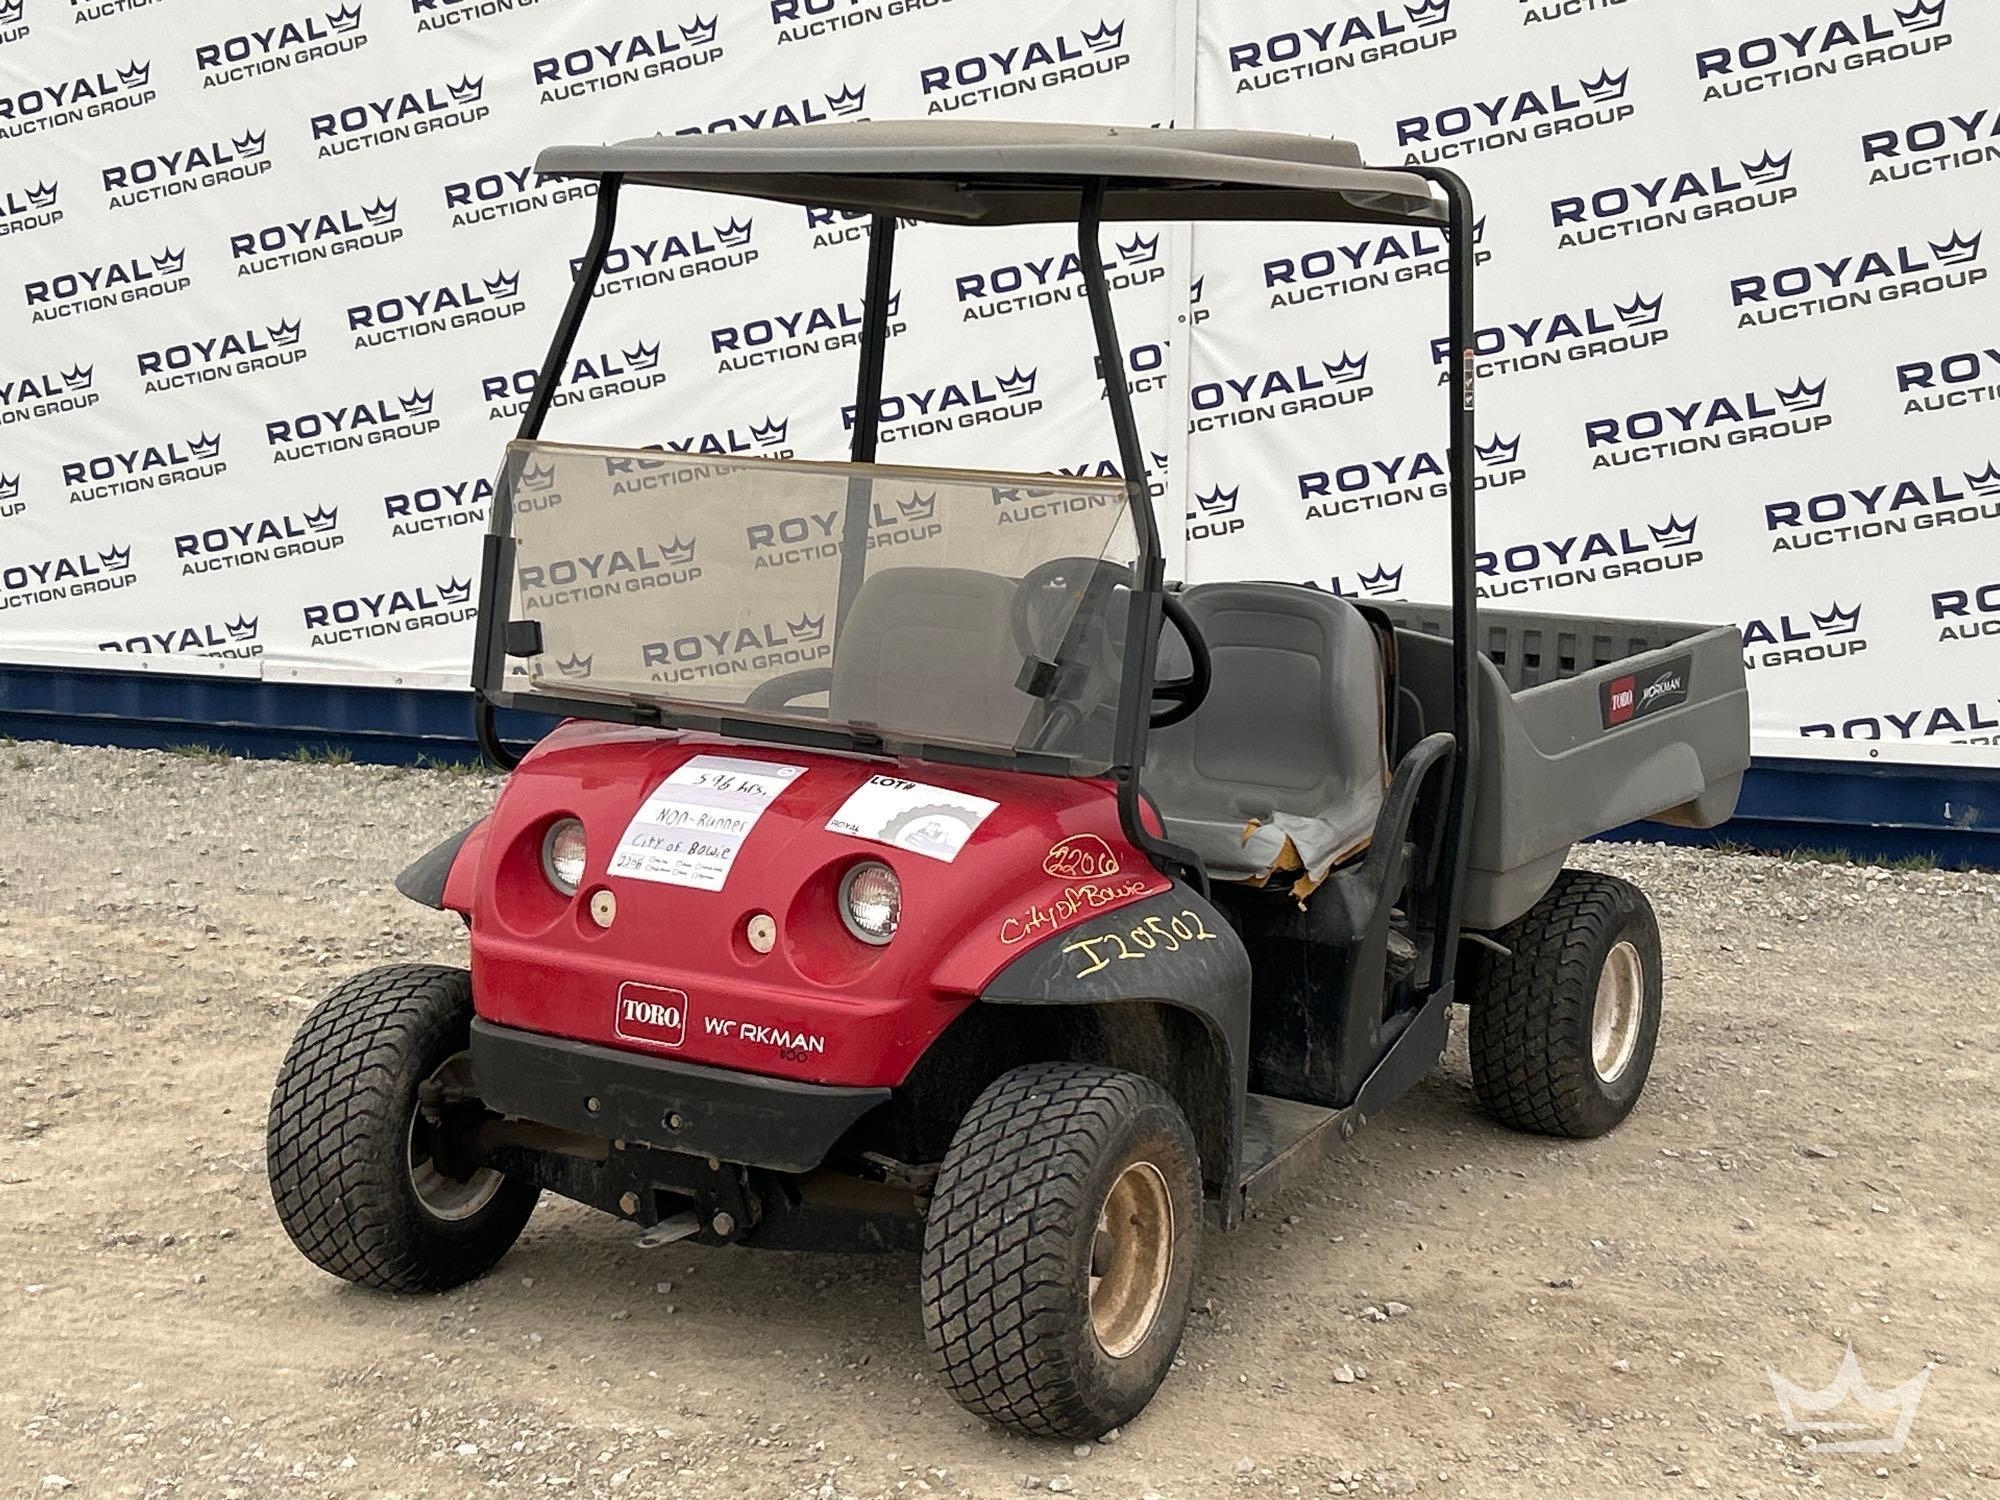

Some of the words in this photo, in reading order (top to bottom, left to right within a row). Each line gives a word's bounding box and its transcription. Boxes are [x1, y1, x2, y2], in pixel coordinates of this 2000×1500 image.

[75, 0, 161, 24] AUCTIO
[418, 0, 512, 34] AUCTION
[778, 6, 882, 45] AUCTION
[196, 18, 328, 71] ROYAL
[203, 54, 291, 89] AUCTION
[295, 35, 367, 64] GROUP
[533, 30, 681, 86] ROYAL
[920, 36, 1083, 95] ROYAL
[1229, 10, 1406, 73] ROYAL
[1237, 53, 1354, 94] AUCTION
[1361, 29, 1457, 64] GROUP
[1696, 14, 1895, 80] ROYAL
[541, 68, 639, 105] AUCTION
[644, 47, 724, 78] GROUP
[928, 77, 1036, 115] AUCTION
[1042, 54, 1130, 87] GROUP
[1704, 59, 1836, 102] AUCTION
[1844, 34, 1952, 70] GROUP
[0, 109, 82, 141] AUCTION
[87, 90, 156, 118] GROUP
[311, 88, 449, 140] ROYAL
[318, 125, 410, 159] AUCTION
[414, 106, 489, 135] GROUP
[1396, 85, 1580, 147] ROYAL
[1404, 128, 1526, 168] AUCTION
[1534, 105, 1634, 139] GROUP
[1861, 104, 2000, 163] ROY
[102, 142, 234, 192] ROYAL
[110, 178, 197, 210] AUCTION
[201, 160, 272, 187] GROUP
[445, 166, 564, 209] ROYA
[453, 194, 547, 228] AUCTION
[552, 183, 599, 204] GRO
[1551, 167, 1742, 228] ROYAL
[1559, 210, 1686, 249] AUCTION
[1693, 187, 1797, 221] GROUP
[0, 210, 64, 236] GROUP
[231, 210, 364, 259] ROYAL
[238, 246, 326, 277] AUCTION
[331, 228, 403, 255] GROUP
[590, 268, 674, 298] UCTION
[679, 250, 759, 278] GROUP
[1263, 231, 1440, 288] ROYAL
[25, 259, 153, 306] ROYAL
[32, 293, 117, 324] AUCTION
[121, 277, 191, 303] GROUP
[955, 252, 1118, 302] ROYA
[1271, 272, 1388, 309] AUCTION
[1395, 251, 1491, 283] GROP
[1730, 247, 1930, 307] ROYAL
[1738, 290, 1871, 329] AUCTION
[1879, 268, 1987, 301] GROUP
[347, 283, 485, 331] ROYAL
[355, 318, 446, 350] AUCTION
[451, 302, 526, 328] GROUP
[711, 303, 863, 354] ROYAL
[963, 287, 1071, 322] AUCTION
[137, 330, 268, 376] ROYAL
[145, 365, 232, 394] AUCTION
[236, 349, 307, 374] GROUP
[719, 341, 819, 374] AUCTION
[1438, 350, 1561, 386] ACTION
[1568, 330, 1668, 361] GROUP
[0, 375, 63, 405] YAL
[481, 354, 625, 402] ROAL
[589, 373, 667, 400] GROUP
[1190, 365, 1325, 411] OYAL
[1904, 382, 2000, 415] AUCTI
[33, 393, 100, 417] GROUP
[266, 400, 401, 446] ROYAL
[880, 417, 953, 443] CTION
[958, 400, 1043, 428] GROUP
[1187, 405, 1275, 435] UCTION
[1282, 386, 1375, 416] GROUP
[1585, 393, 1776, 449] ROYAL
[62, 443, 189, 487] ROYAL
[274, 435, 363, 464] AUCTION
[367, 419, 440, 444] GROUP
[1593, 434, 1720, 470] AUCTION
[1728, 415, 1832, 446] GROUP
[70, 476, 154, 504] AUCTION
[158, 462, 227, 486] GROUP
[384, 478, 499, 519] ROYA
[613, 465, 710, 496] AUCTION
[1298, 451, 1449, 500] ROYA
[1306, 487, 1423, 520] AUCTION
[1430, 469, 1526, 498] GOUP
[392, 509, 484, 537] AUCTION
[514, 494, 563, 513] OUP
[746, 503, 898, 551] ROYL
[998, 493, 1106, 525] AUCTION
[1765, 476, 1964, 531] ROYAL
[174, 516, 306, 558] ROYAL
[1188, 519, 1246, 539] OUP
[1773, 518, 1906, 553] AUCTION
[1914, 503, 2000, 530] GROU
[3, 555, 101, 590] OYAL
[183, 549, 269, 576] AUCTION
[273, 535, 344, 559] GROUP
[518, 547, 661, 592] ROYAL
[754, 543, 841, 570] AUCTIO
[1475, 528, 1649, 580] ROYAL
[1475, 568, 1595, 601] AUCTION
[1603, 551, 1703, 579] GROUP
[0, 587, 67, 610] UCTION
[70, 574, 138, 596] GROUP
[303, 587, 438, 630] ROYAL
[526, 582, 621, 610] AUCTION
[625, 568, 703, 592] GROUP
[312, 621, 401, 648] AUCTION
[405, 608, 478, 631] GROUP
[641, 624, 788, 668] ROYAL
[752, 645, 832, 669] GROUP
[1763, 639, 1867, 667] GROUP
[870, 776, 917, 791] LOT#
[623, 998, 679, 1028] TORO
